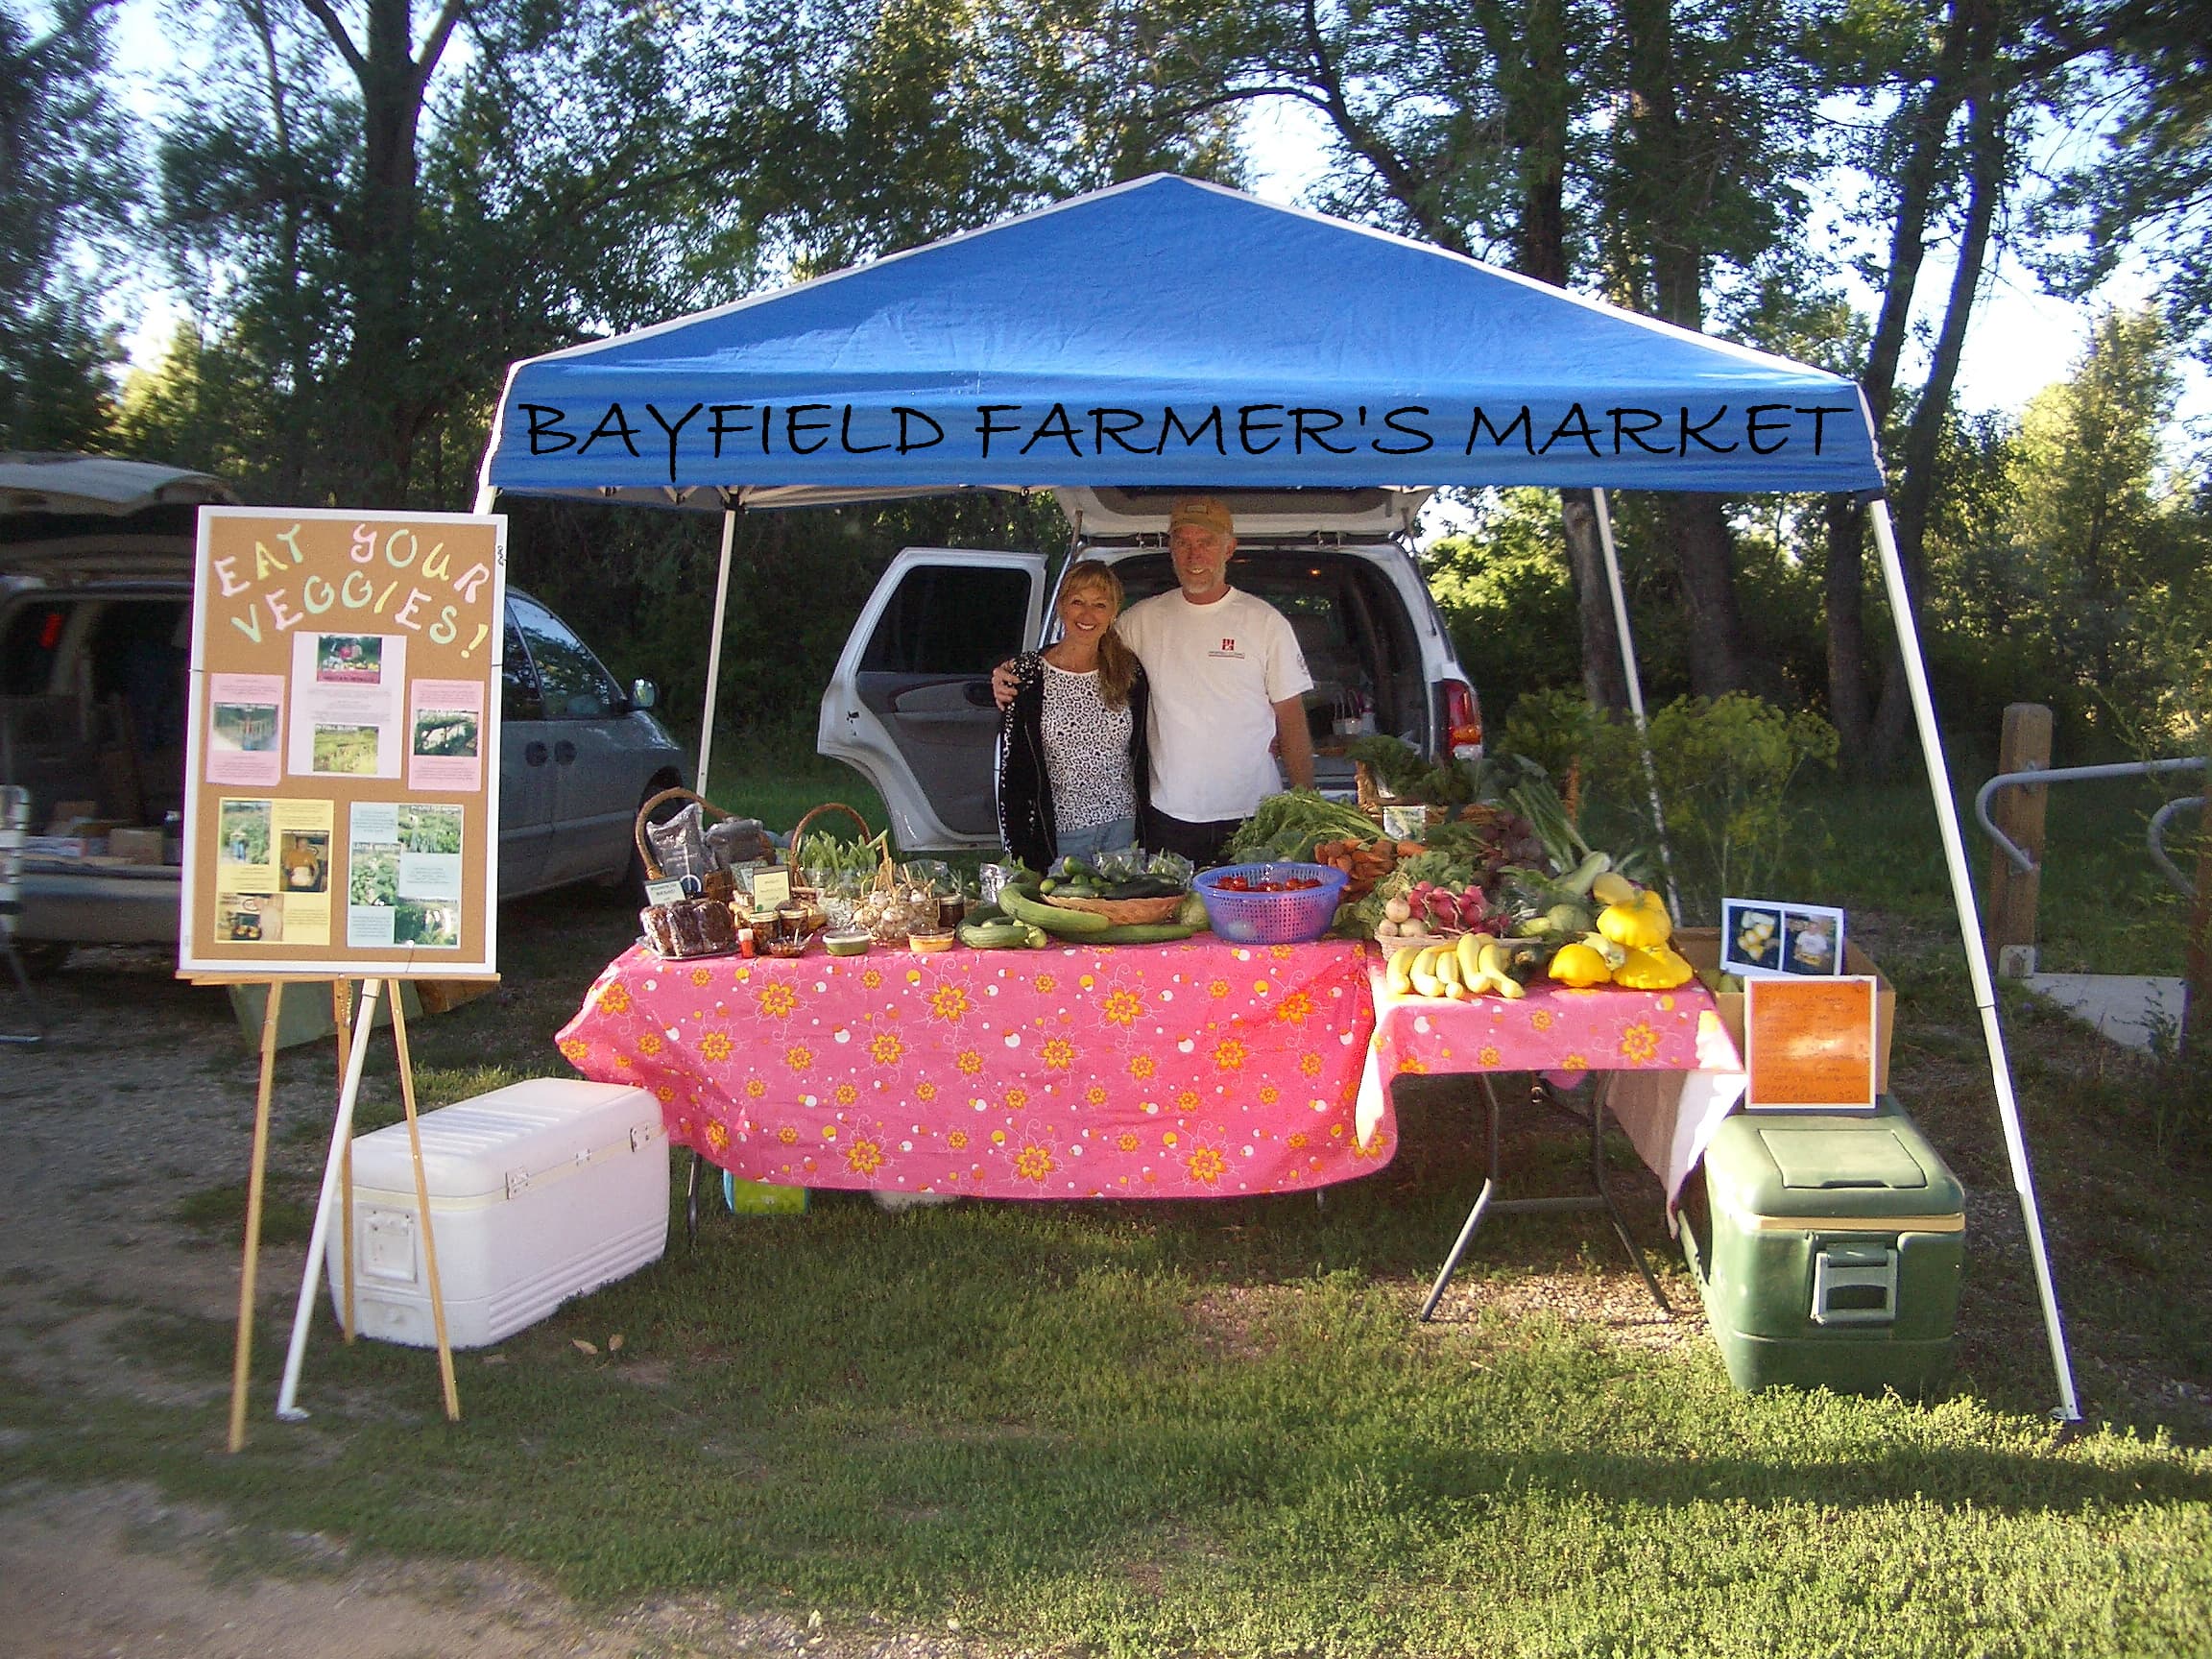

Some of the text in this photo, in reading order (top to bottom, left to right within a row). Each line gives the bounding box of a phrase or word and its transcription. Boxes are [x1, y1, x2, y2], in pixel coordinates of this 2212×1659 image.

[213, 523, 490, 603] EAT YOUR
[230, 570, 489, 659] VEGGIES!
